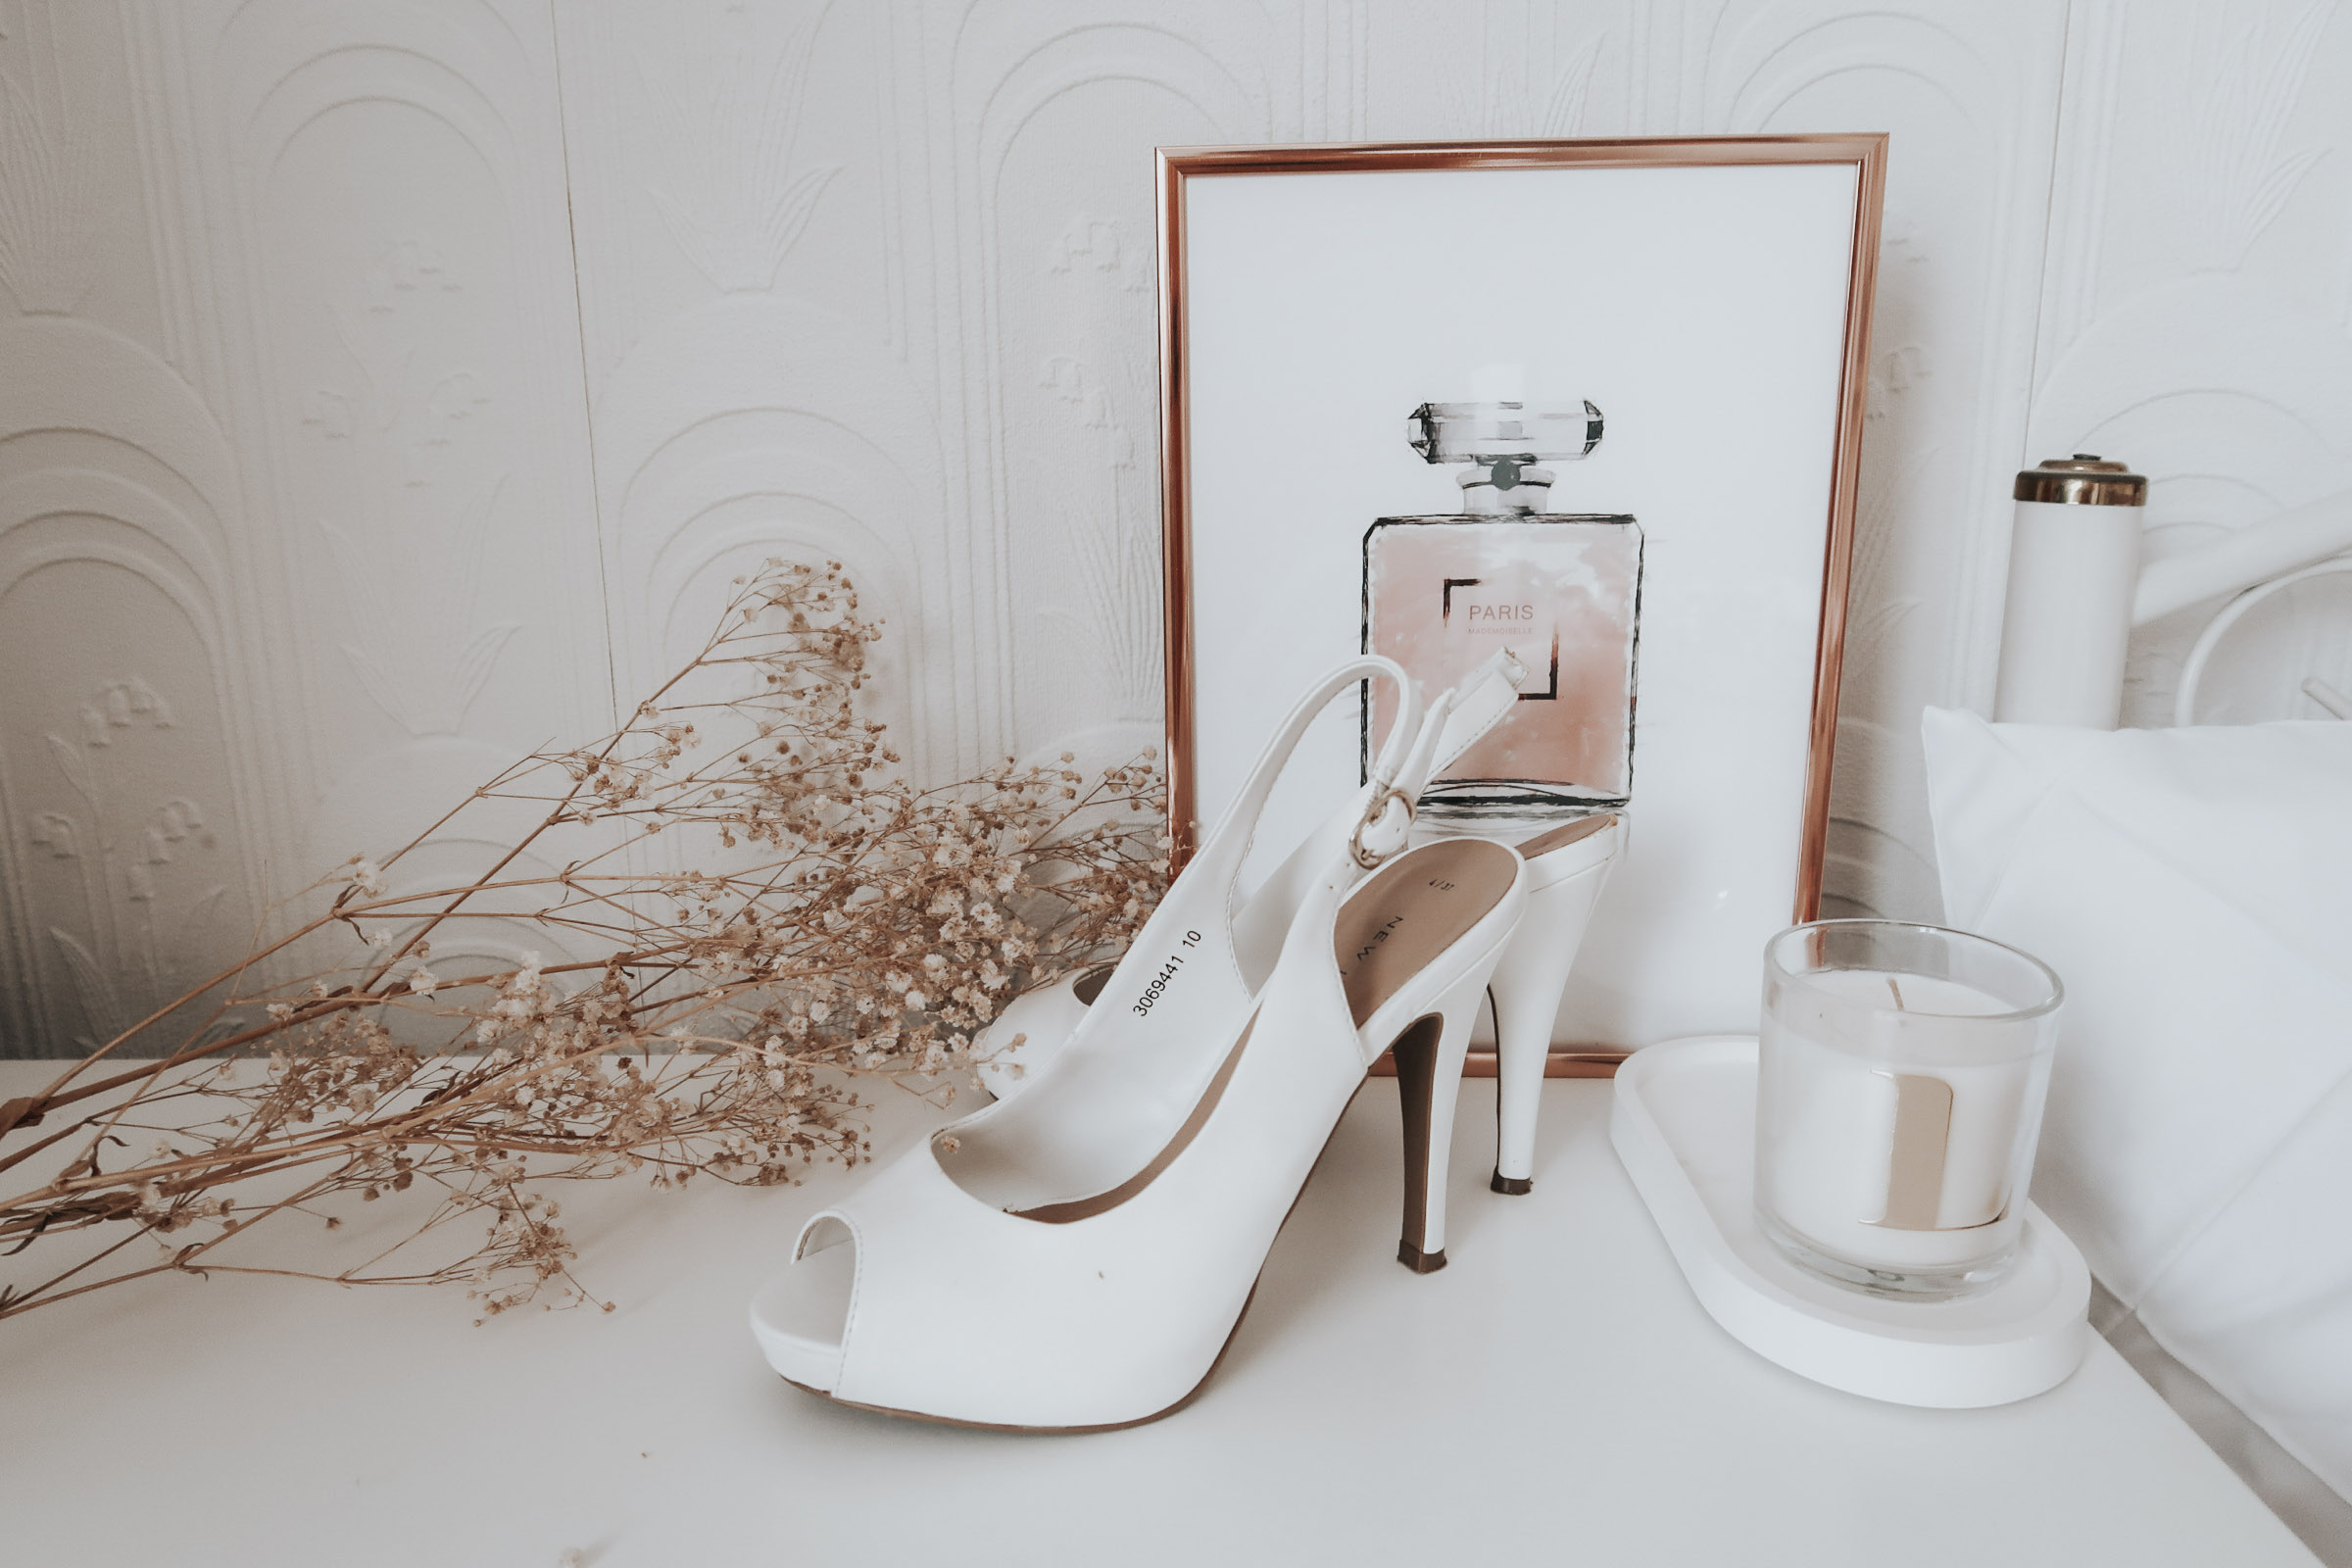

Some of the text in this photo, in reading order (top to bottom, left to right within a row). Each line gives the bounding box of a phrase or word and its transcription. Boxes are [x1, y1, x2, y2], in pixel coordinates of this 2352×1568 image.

[1469, 605, 1534, 620] PARIS
[1356, 916, 1403, 961] NEW
[1133, 930, 1201, 1016] 3069441 10
